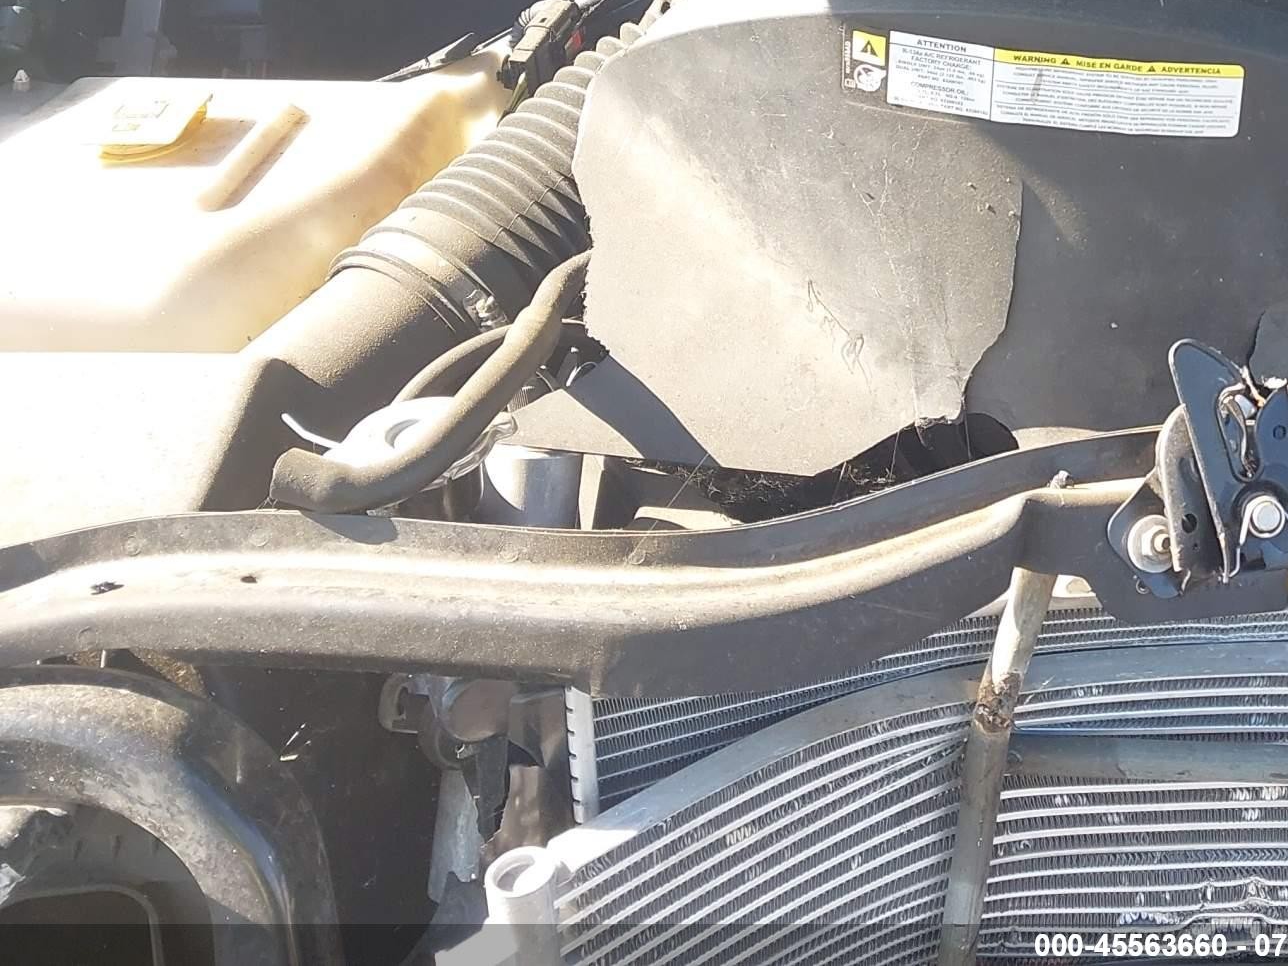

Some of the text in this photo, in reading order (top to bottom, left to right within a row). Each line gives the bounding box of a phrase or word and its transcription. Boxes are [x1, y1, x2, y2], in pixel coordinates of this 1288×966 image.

[916, 38, 967, 53] ATTENTION
[911, 55, 941, 65] FACTORY
[936, 53, 981, 65] REFRIGERANT
[1013, 55, 1057, 64] WARNING
[1075, 60, 1097, 69] MISE
[1113, 63, 1143, 72] GARDE
[1161, 66, 1221, 75] ADVERTENCIA
